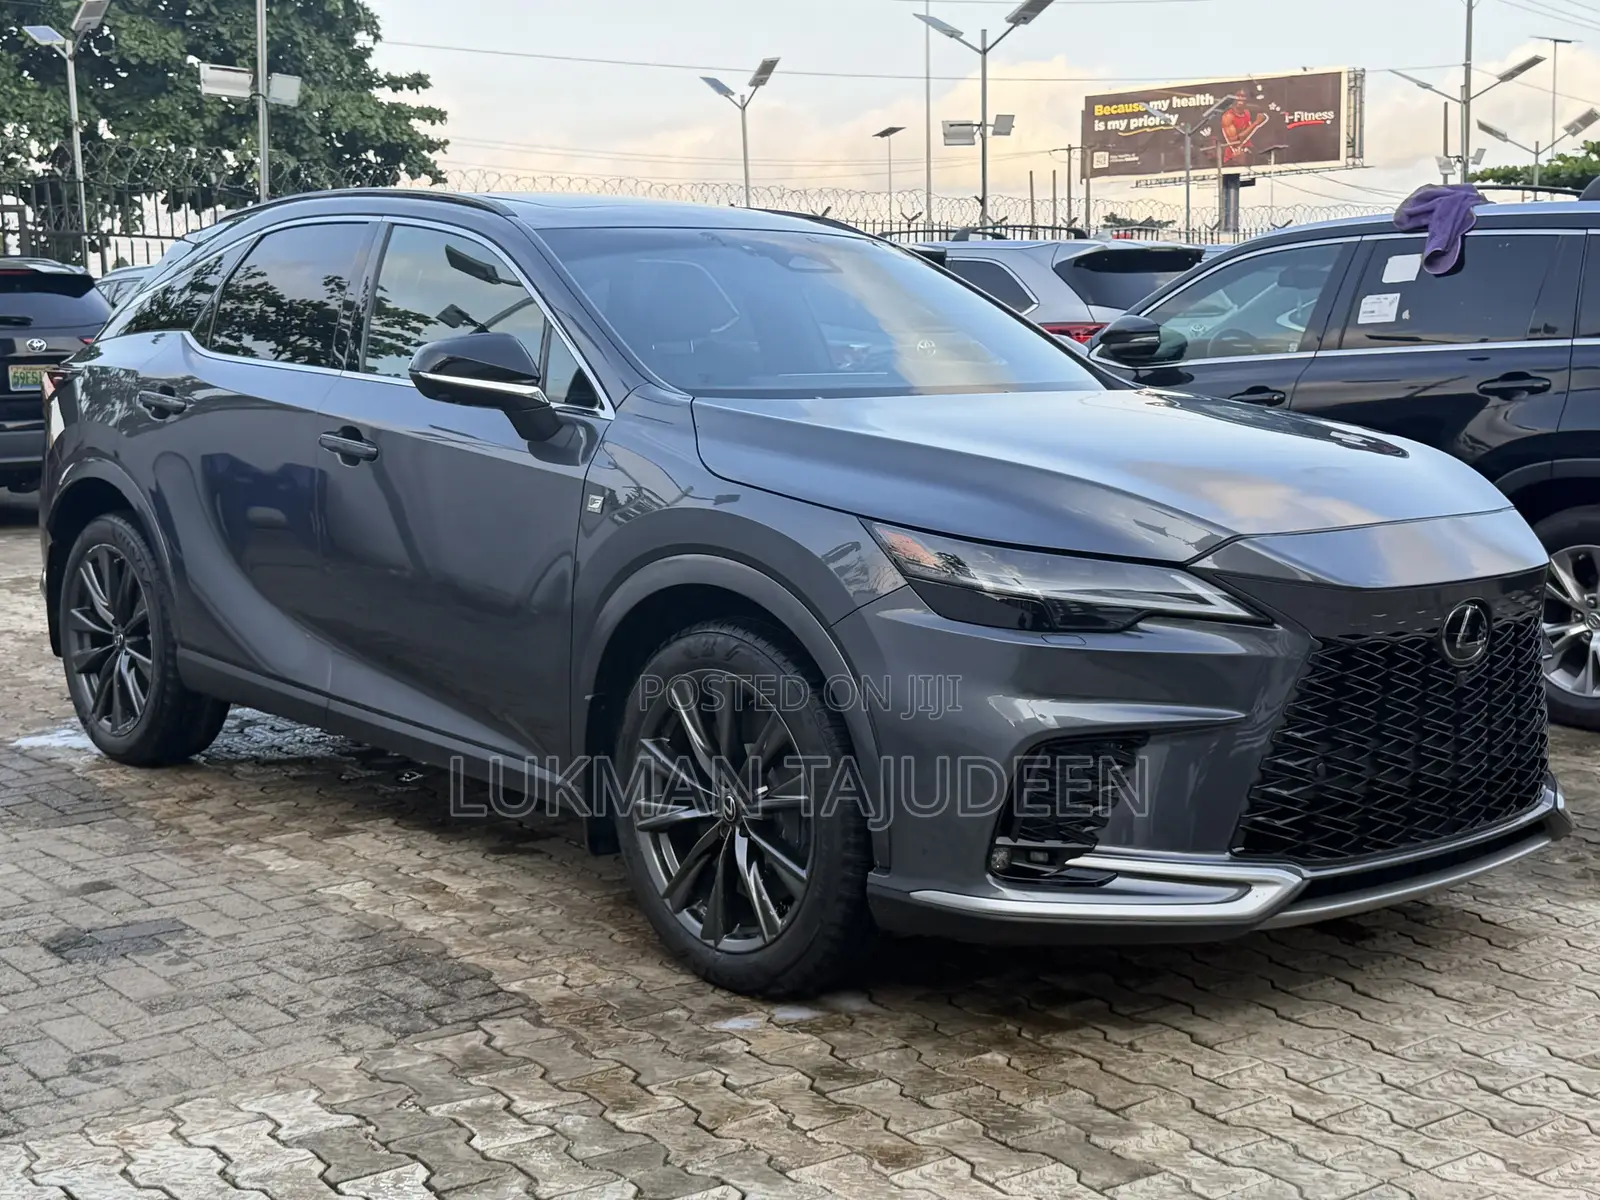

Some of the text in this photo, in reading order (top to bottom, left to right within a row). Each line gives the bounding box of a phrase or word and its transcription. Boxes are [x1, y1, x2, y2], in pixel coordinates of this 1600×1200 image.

[1094, 93, 1214, 116] Because my health
[1094, 113, 1179, 131] is my priory
